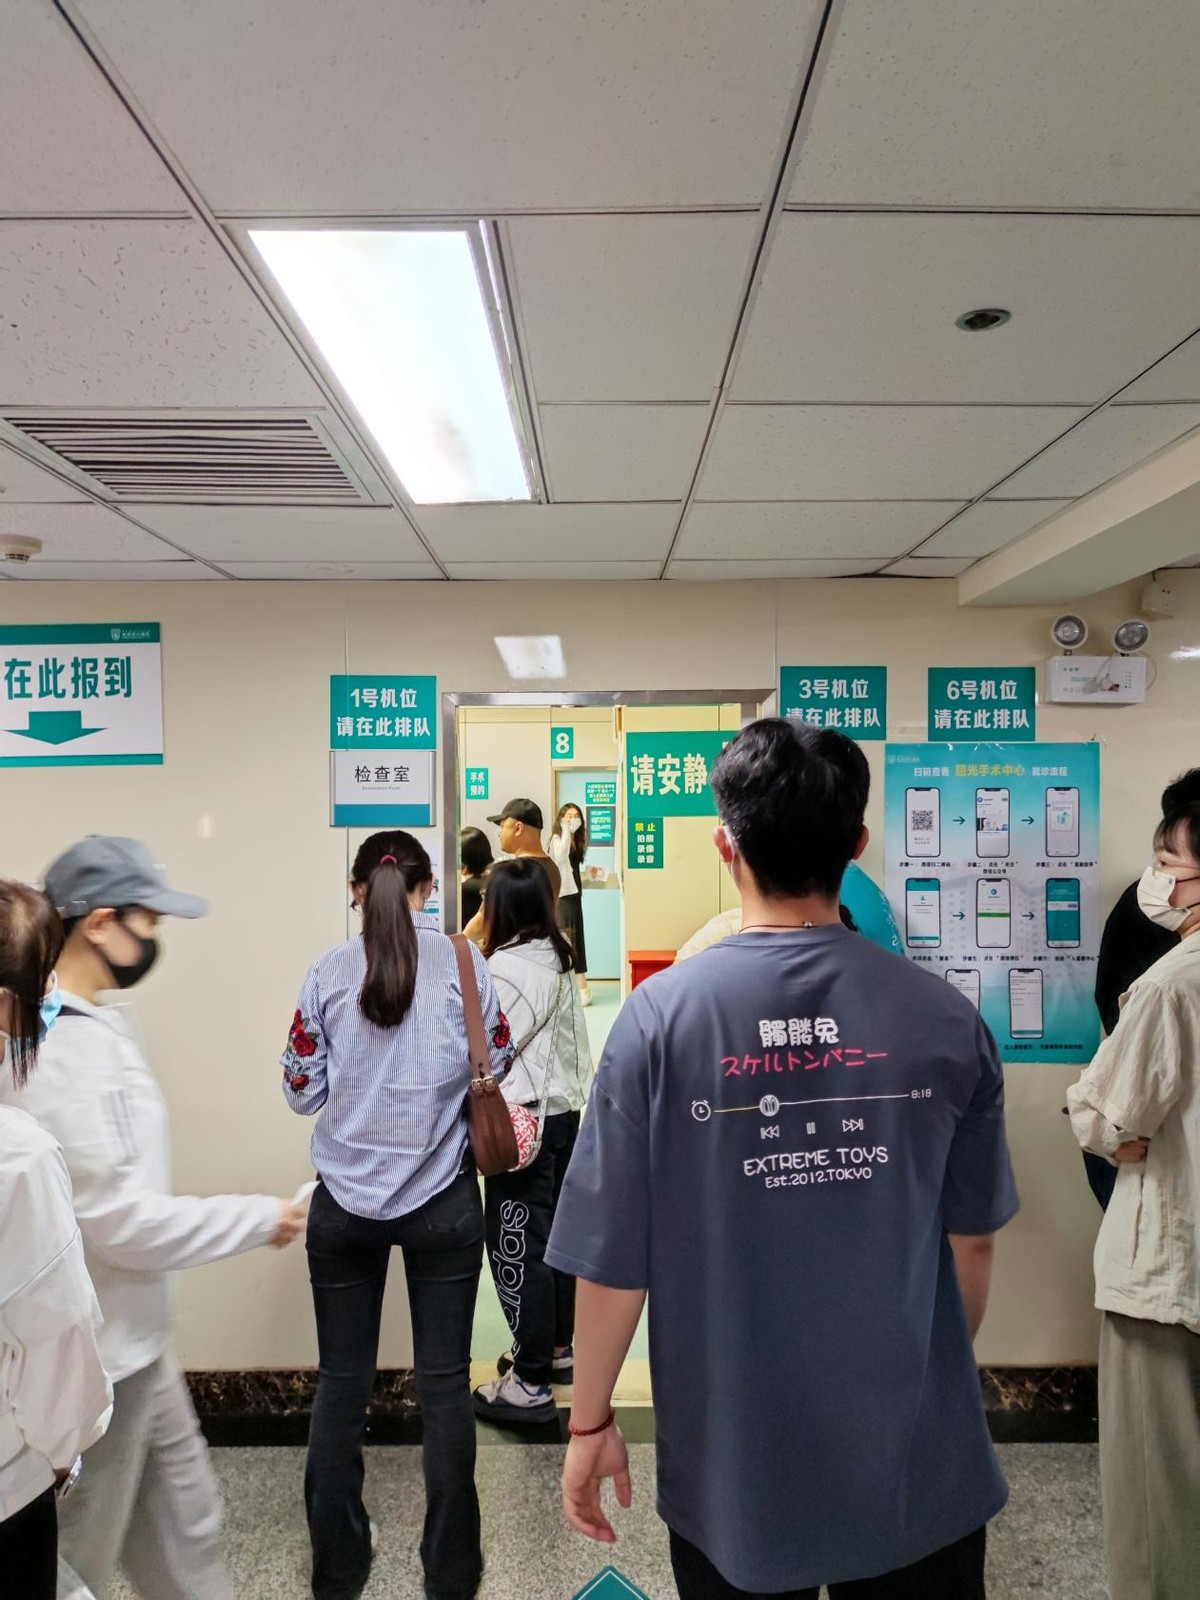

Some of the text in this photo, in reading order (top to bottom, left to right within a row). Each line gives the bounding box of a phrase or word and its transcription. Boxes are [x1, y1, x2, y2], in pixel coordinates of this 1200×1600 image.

[3, 655, 132, 700] 在此报到
[350, 688, 418, 709] 1号机位
[799, 678, 869, 700] 3号机位
[946, 679, 1018, 701] 6号机位
[336, 715, 431, 738] 请在此排队
[933, 708, 1030, 730] 请在此排队
[555, 732, 570, 754] 8
[354, 764, 411, 784] 检查室
[630, 753, 708, 796] 请安静
[911, 1088, 932, 1099] 8:18
[743, 1146, 889, 1176] EXTREME TOYS
